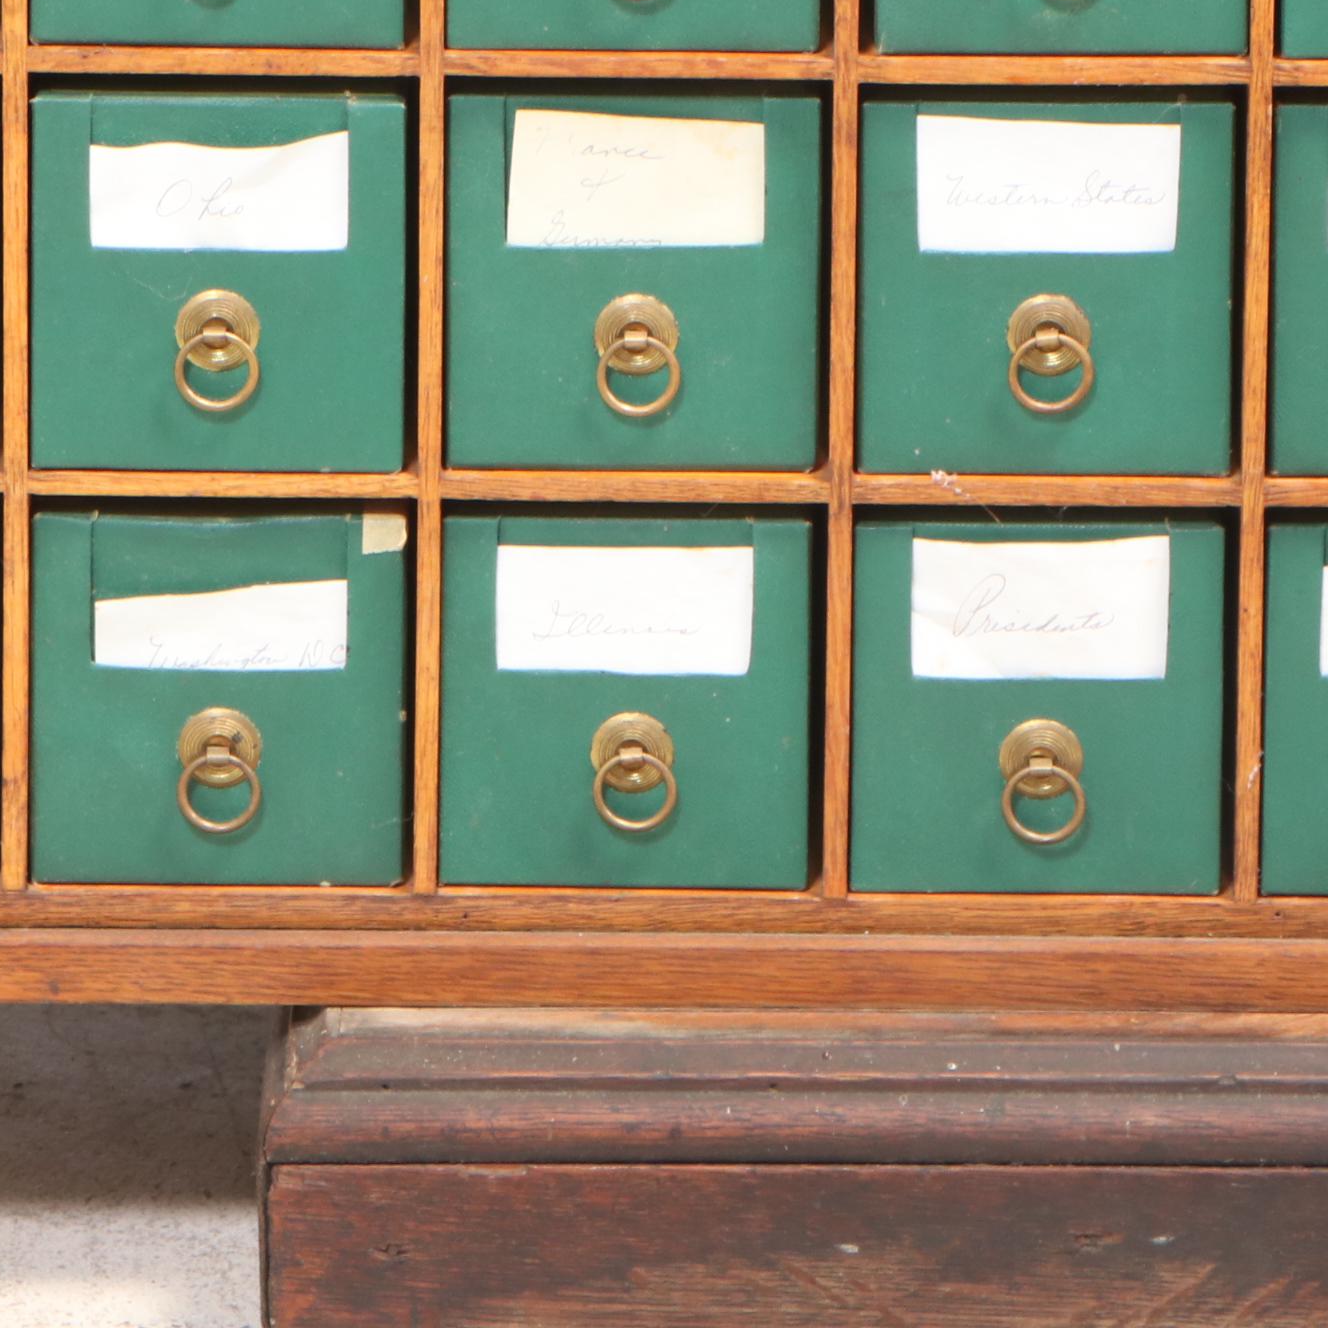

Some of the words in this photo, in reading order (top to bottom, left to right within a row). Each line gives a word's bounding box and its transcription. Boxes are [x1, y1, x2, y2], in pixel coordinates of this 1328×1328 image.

[155, 176, 245, 221] Ohio
[945, 174, 1069, 208] Western
[1071, 168, 1167, 209] States
[532, 599, 703, 642] Illinois
[952, 572, 1116, 637] Presidents
